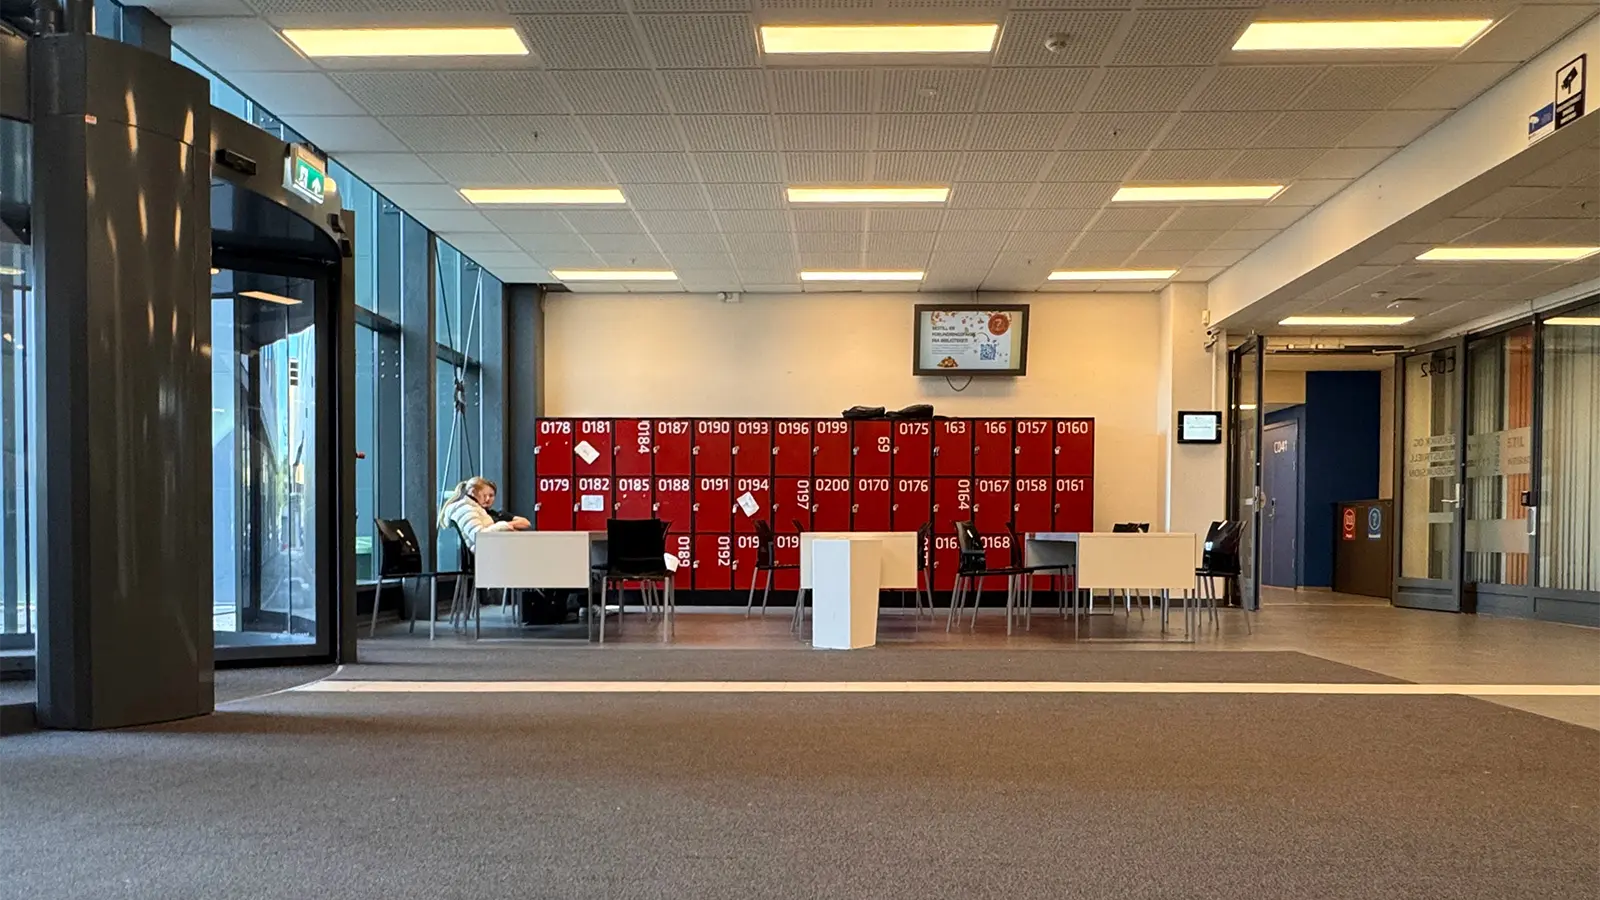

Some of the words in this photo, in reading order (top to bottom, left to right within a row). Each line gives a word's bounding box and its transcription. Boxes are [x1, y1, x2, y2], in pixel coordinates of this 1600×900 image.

[541, 421, 570, 434] 0178
[583, 421, 610, 433] 0181
[659, 422, 688, 434] 0187
[699, 421, 729, 433] 0190
[739, 422, 768, 434] 0193
[779, 422, 809, 434] 0196
[818, 422, 847, 433] 0199
[900, 423, 928, 434] 0175
[945, 422, 965, 433] 163
[985, 422, 1006, 433] 166
[1018, 422, 1047, 433] 0157
[1058, 422, 1088, 433] 0160
[637, 420, 650, 454] 0184
[878, 437, 890, 452] 69
[540, 479, 569, 491] 0179
[579, 478, 609, 490] 0182
[619, 479, 649, 491] 0185
[659, 479, 689, 491] 0188
[701, 478, 728, 490] 0191
[738, 479, 769, 491] 0194
[816, 479, 849, 491] 0200
[859, 479, 888, 491] 0170
[899, 480, 928, 491] 0176
[980, 480, 1009, 492] 0167
[1017, 480, 1046, 491] 0158
[1057, 480, 1083, 491] 0161
[797, 480, 809, 509] 0197
[958, 480, 970, 509] 0164
[738, 536, 759, 548] 019
[777, 536, 799, 548] 019
[936, 537, 960, 549] 016
[718, 536, 730, 565] 0192
